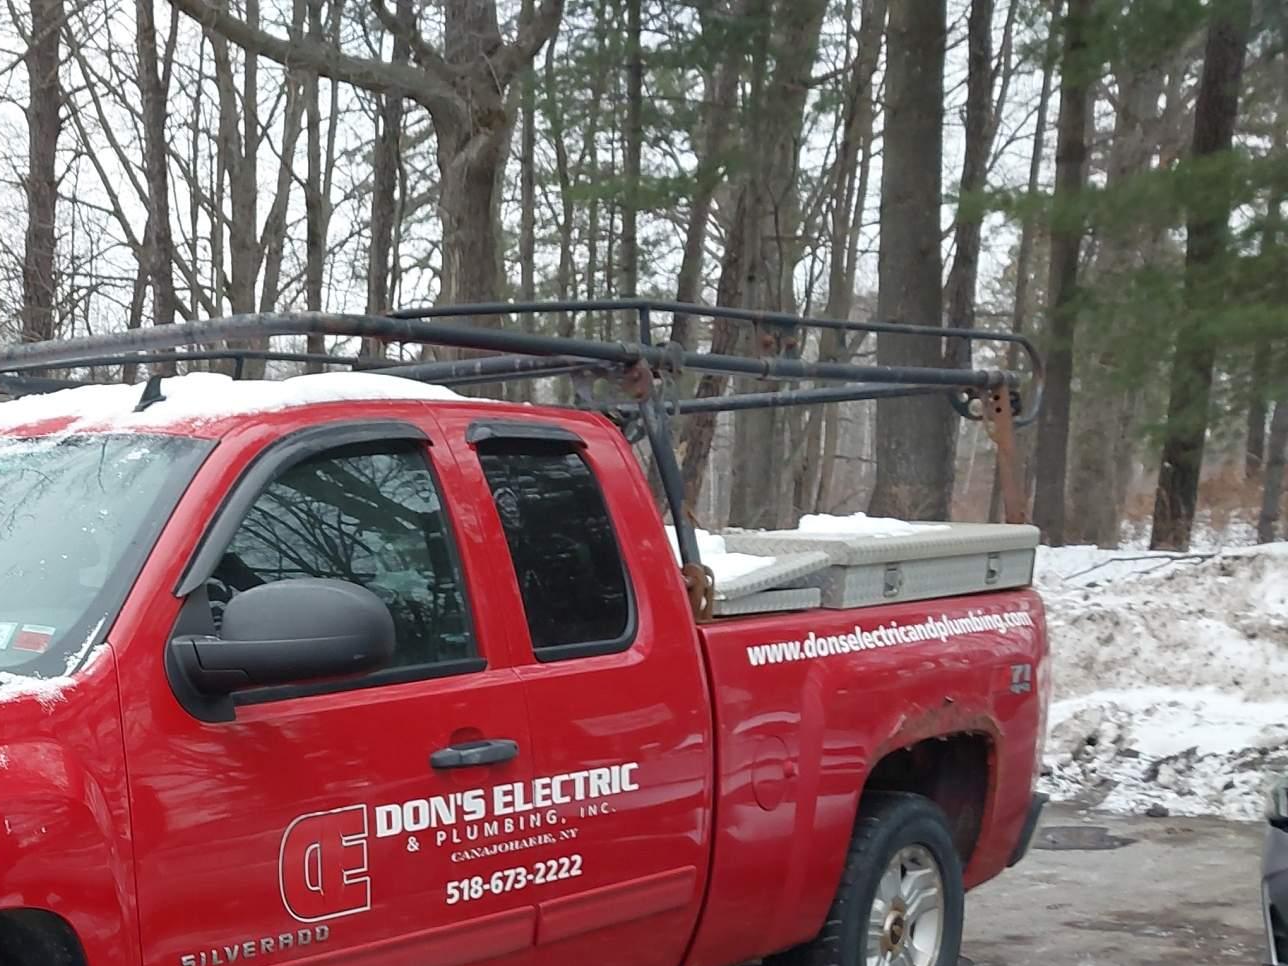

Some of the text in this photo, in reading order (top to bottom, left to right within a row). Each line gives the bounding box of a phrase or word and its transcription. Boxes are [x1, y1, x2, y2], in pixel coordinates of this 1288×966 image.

[746, 610, 1033, 666] www.donselectricandplumbing.com
[375, 762, 639, 838] DON'S ELECTRIC
[406, 836, 420, 852] &
[580, 801, 617, 818] INC.
[560, 828, 580, 841] NY
[445, 854, 584, 905] 518-673-2222
